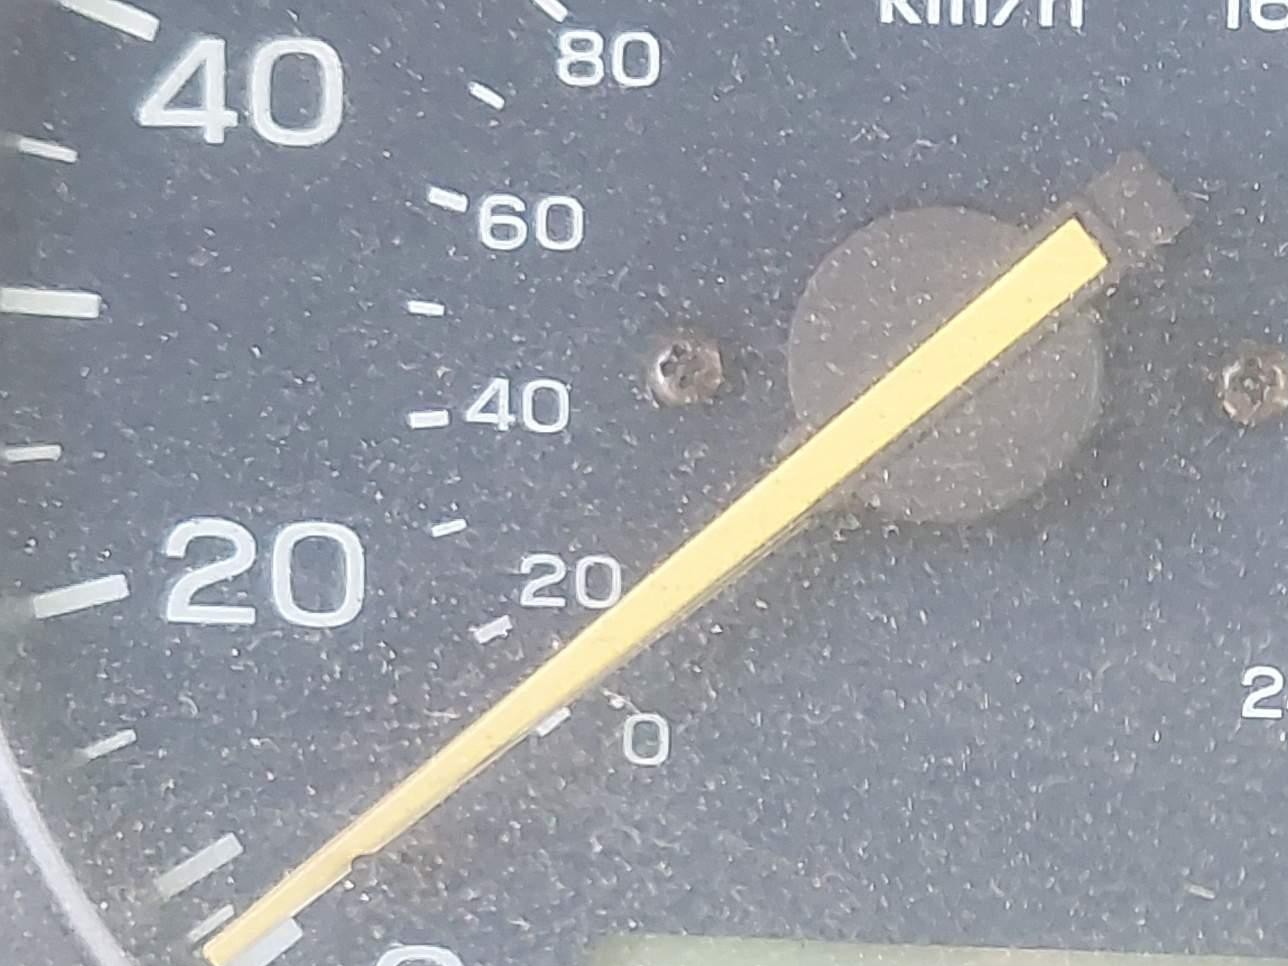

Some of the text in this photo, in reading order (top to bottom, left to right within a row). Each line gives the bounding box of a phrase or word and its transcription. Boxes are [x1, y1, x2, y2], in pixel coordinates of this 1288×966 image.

[556, 30, 661, 88] 80
[137, 37, 345, 147] 40
[477, 194, 585, 251] 60
[464, 377, 571, 433] 40
[164, 517, 365, 629] 20
[519, 554, 622, 611] 20
[622, 712, 671, 767] 0
